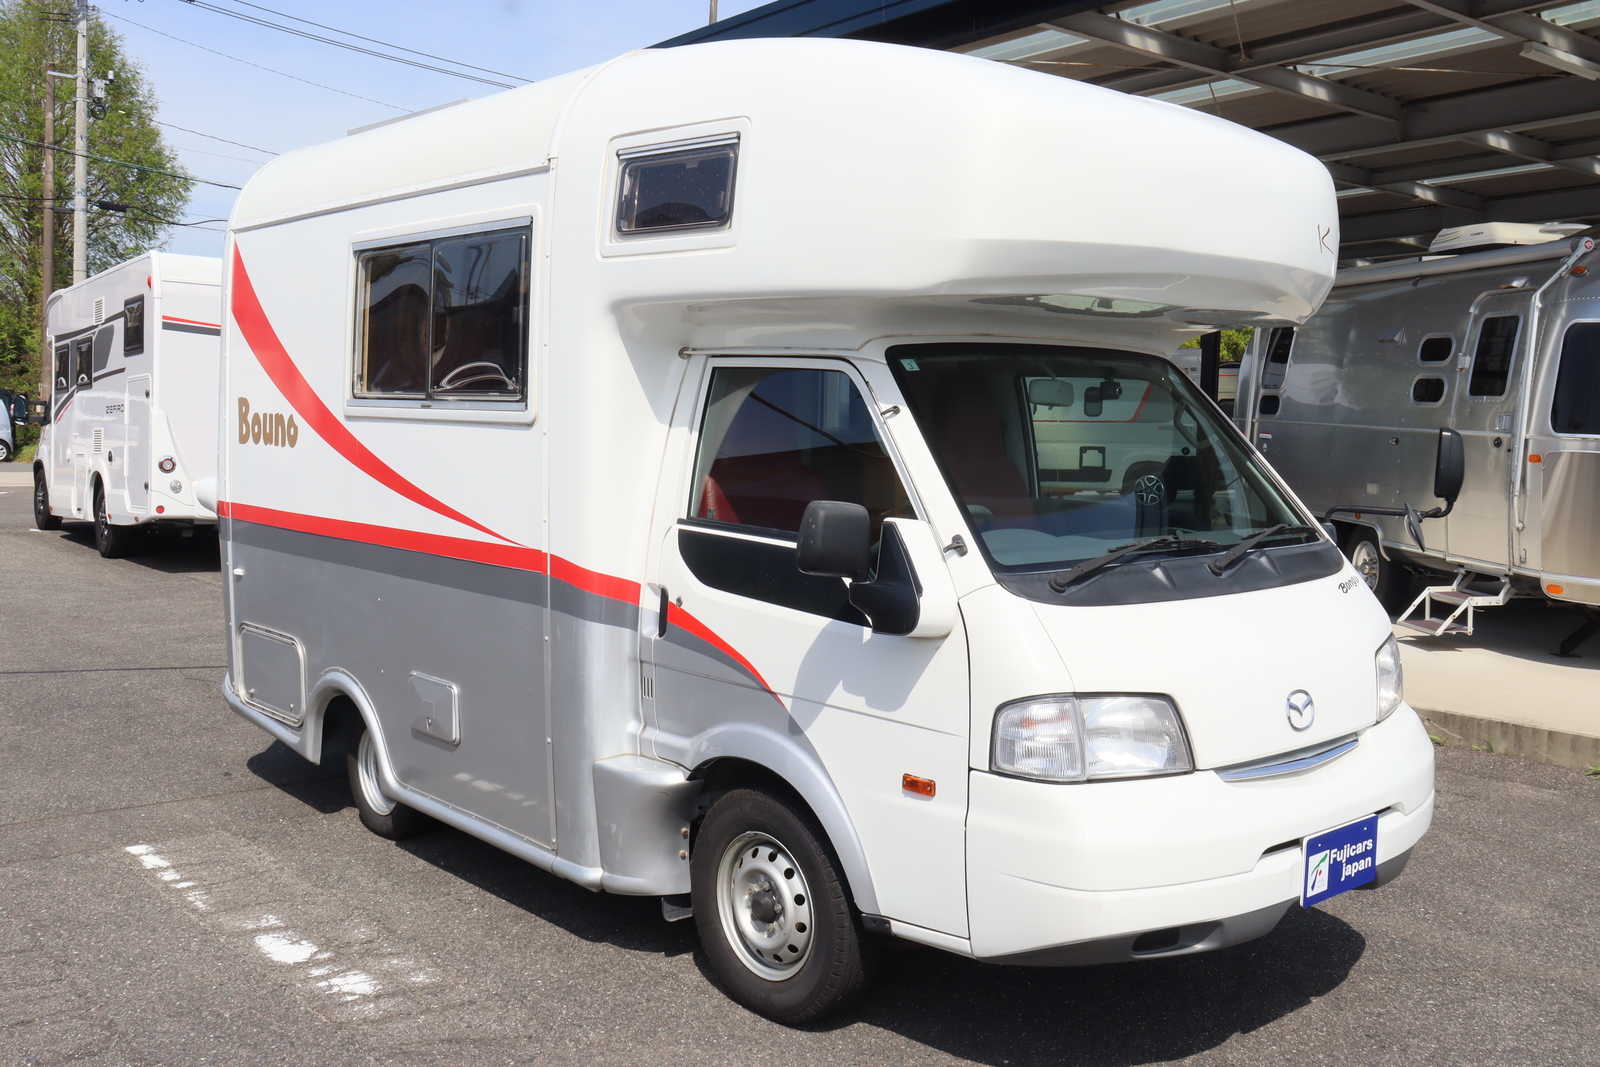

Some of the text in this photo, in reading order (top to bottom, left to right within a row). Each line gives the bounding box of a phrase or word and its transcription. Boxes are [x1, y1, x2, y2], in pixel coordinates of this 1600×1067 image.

[238, 396, 299, 448] Bouno
[1330, 839, 1373, 864] Fujicars
[1341, 857, 1372, 881] japan
